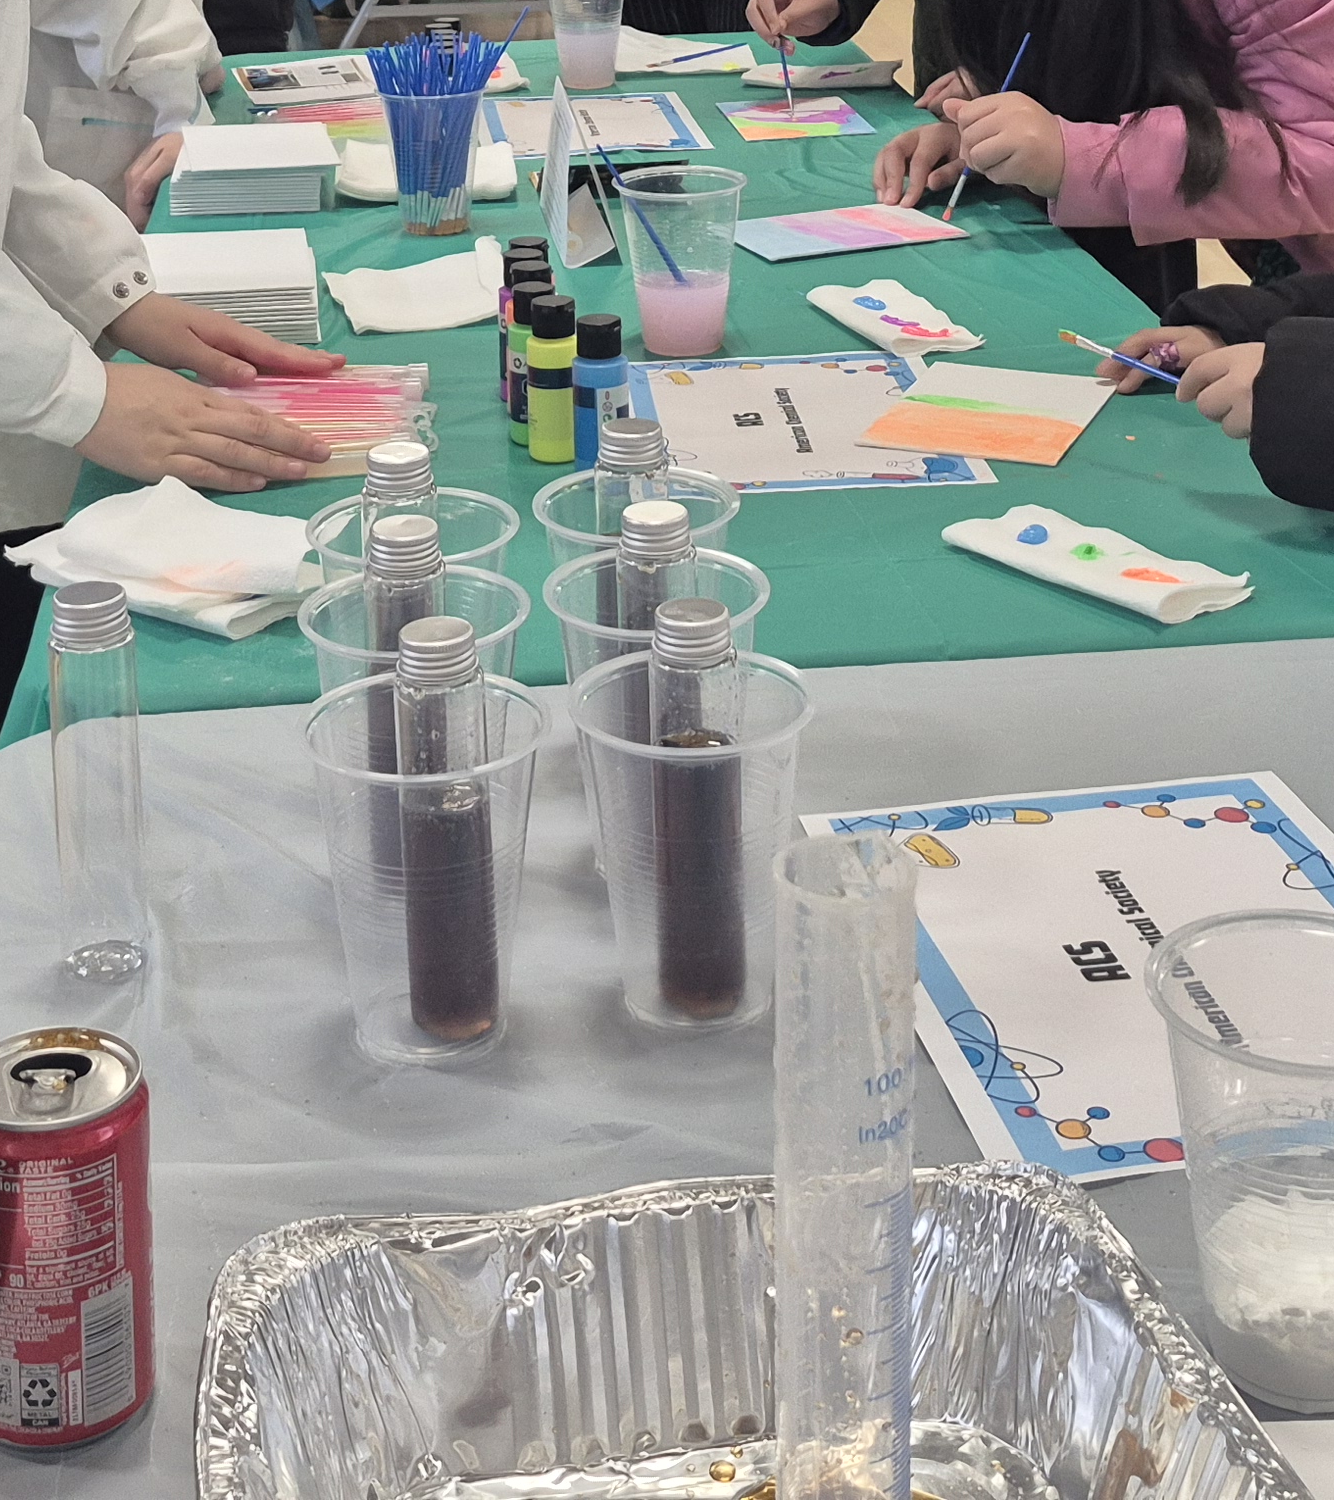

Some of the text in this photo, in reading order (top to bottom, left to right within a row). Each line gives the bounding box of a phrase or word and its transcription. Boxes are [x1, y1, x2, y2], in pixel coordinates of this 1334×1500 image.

[733, 413, 764, 427] ACS
[773, 388, 813, 453] American Chemical Society
[1095, 870, 1145, 916] Society
[1062, 941, 1132, 982] ACS
[864, 1068, 901, 1096] 100
[18, 1158, 73, 1168] ORIGINAL
[9, 1274, 24, 1287] 90
